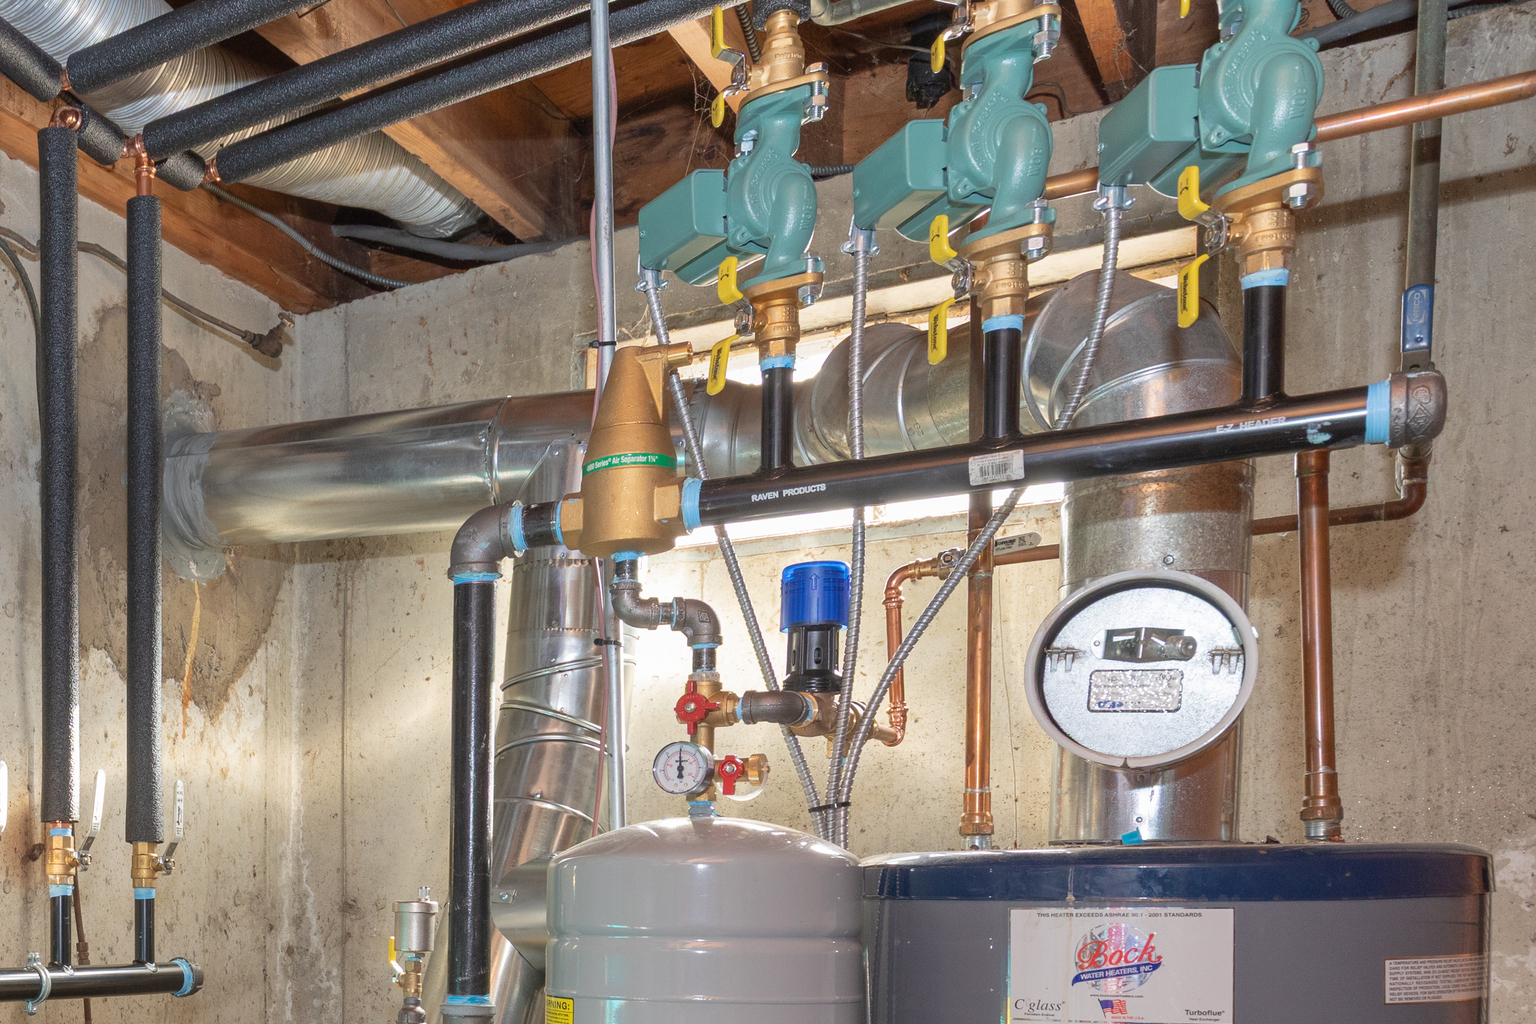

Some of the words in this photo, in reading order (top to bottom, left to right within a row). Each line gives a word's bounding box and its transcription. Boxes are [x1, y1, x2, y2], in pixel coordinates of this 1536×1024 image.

[1216, 422, 1234, 433] E-Z
[1239, 416, 1286, 430] HEADER
[612, 456, 620, 464] Air
[621, 455, 648, 464] Separator
[752, 491, 779, 502] RAVEN
[783, 484, 826, 497] PRODUCTS
[1077, 933, 1163, 970] Bock
[1080, 971, 1104, 980] WATER
